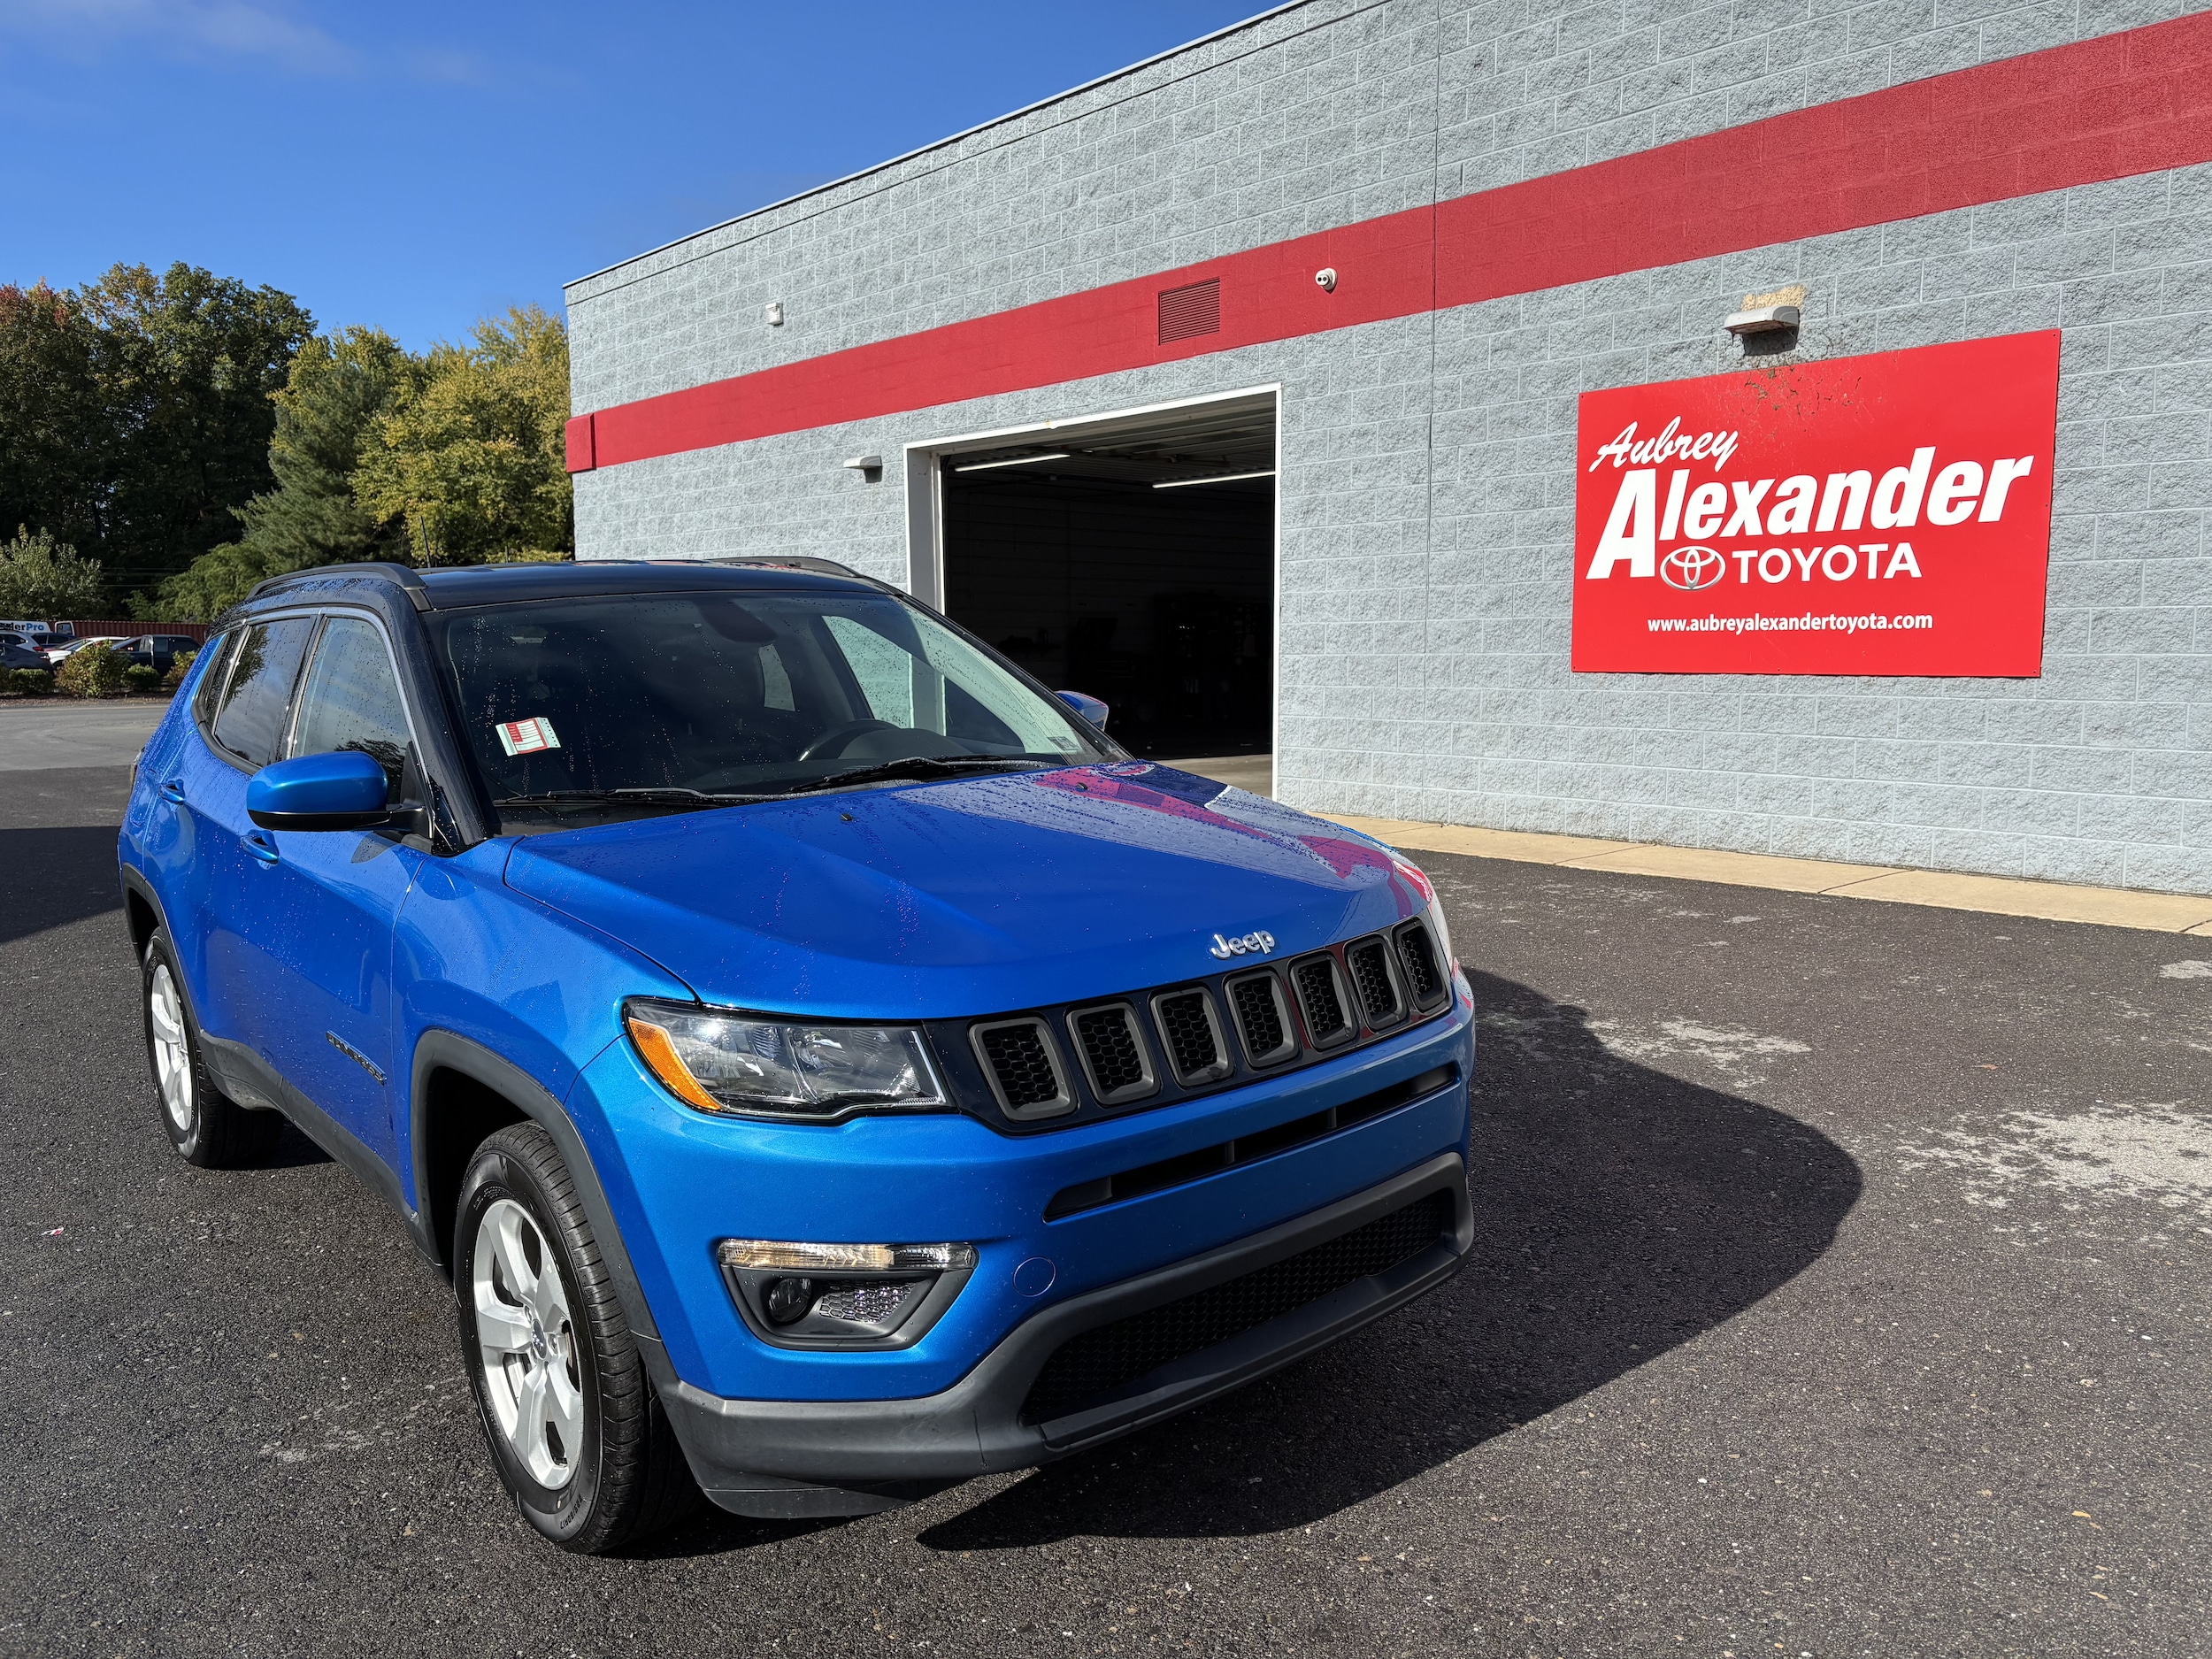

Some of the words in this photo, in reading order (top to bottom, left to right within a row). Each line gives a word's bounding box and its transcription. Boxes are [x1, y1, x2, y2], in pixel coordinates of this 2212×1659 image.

[1589, 416, 1739, 472] Aubrey
[1586, 446, 2033, 580] Alexander
[1732, 542, 1922, 584] TOYOTA
[1647, 611, 1933, 635] www.aubreyalexandertoyota.com
[1210, 930, 1275, 960] Jeep
